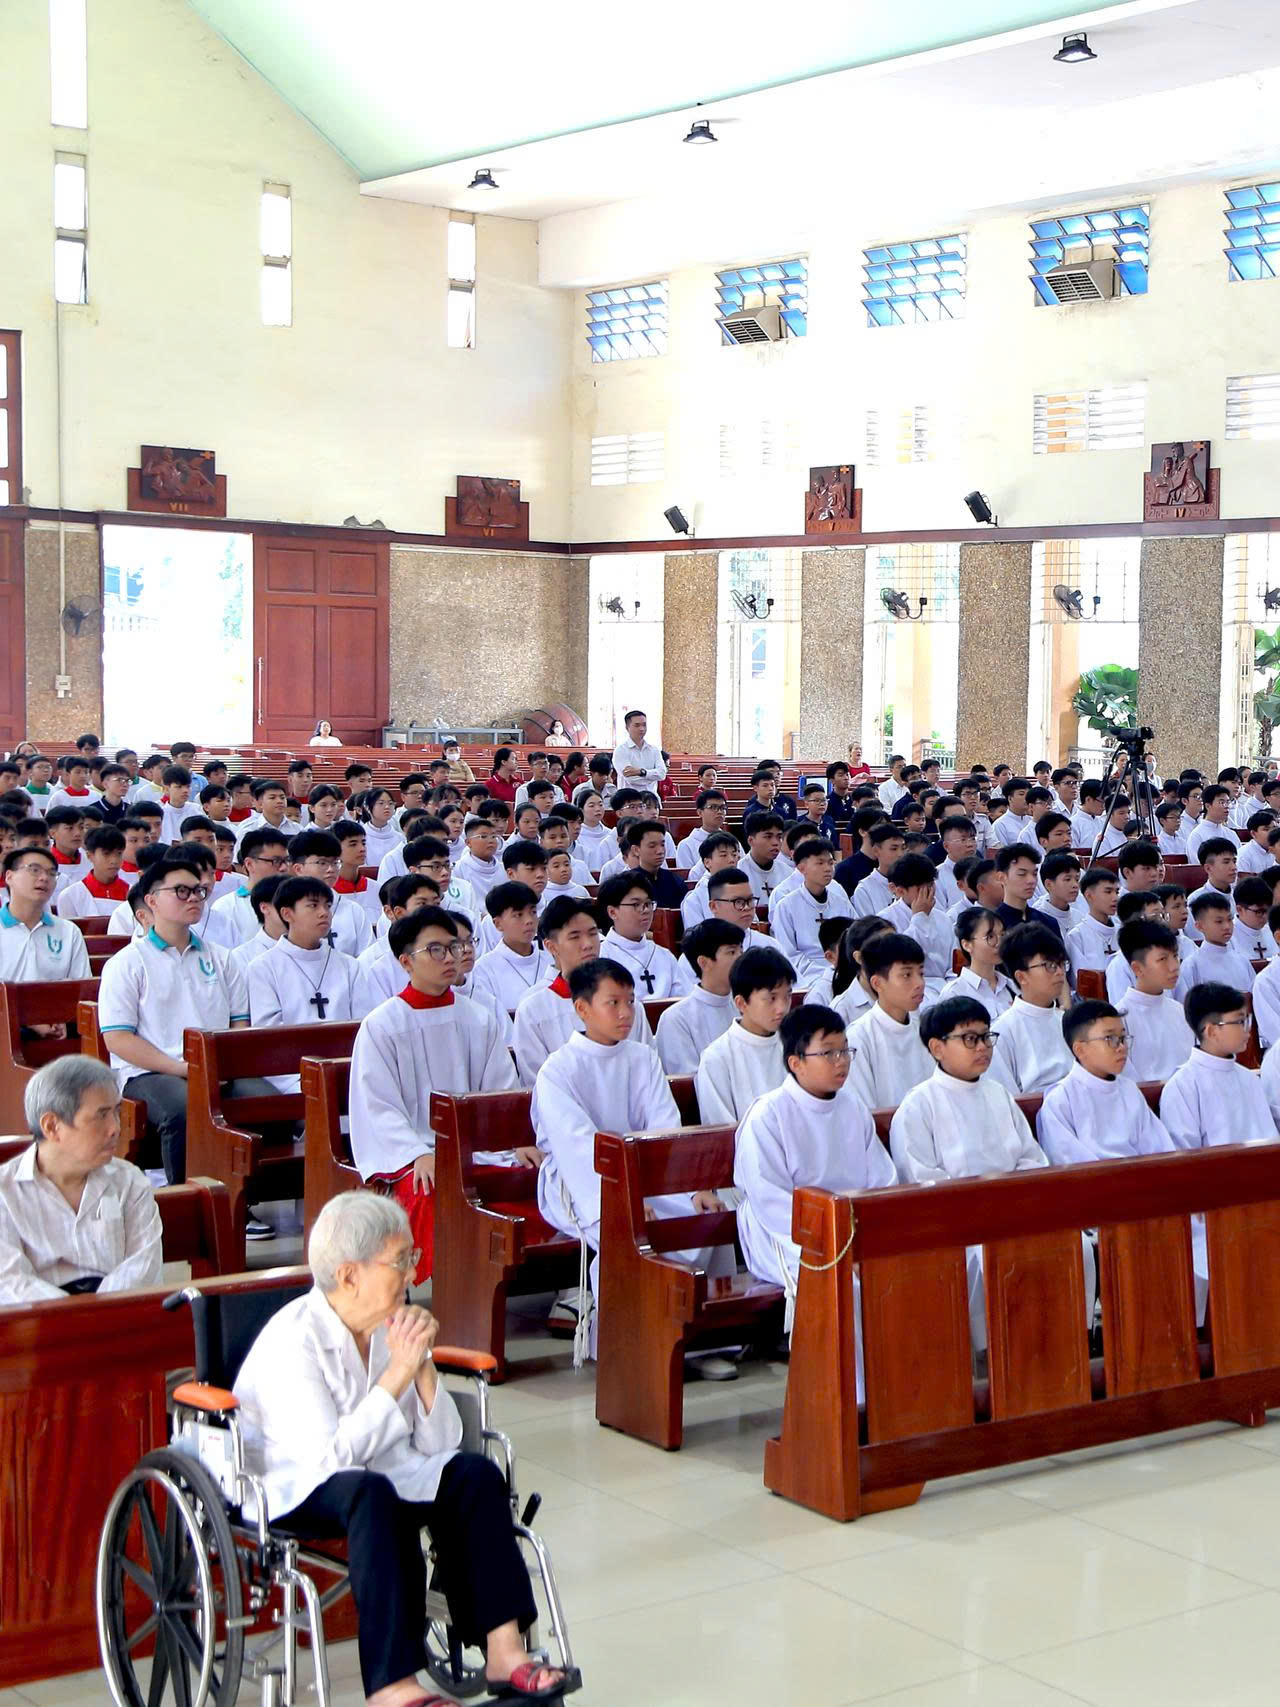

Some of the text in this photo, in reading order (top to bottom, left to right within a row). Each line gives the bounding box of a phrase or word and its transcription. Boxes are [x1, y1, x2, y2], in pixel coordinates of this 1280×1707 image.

[169, 502, 188, 512] VII
[1174, 508, 1185, 518] IV
[483, 528, 494, 537] VI
